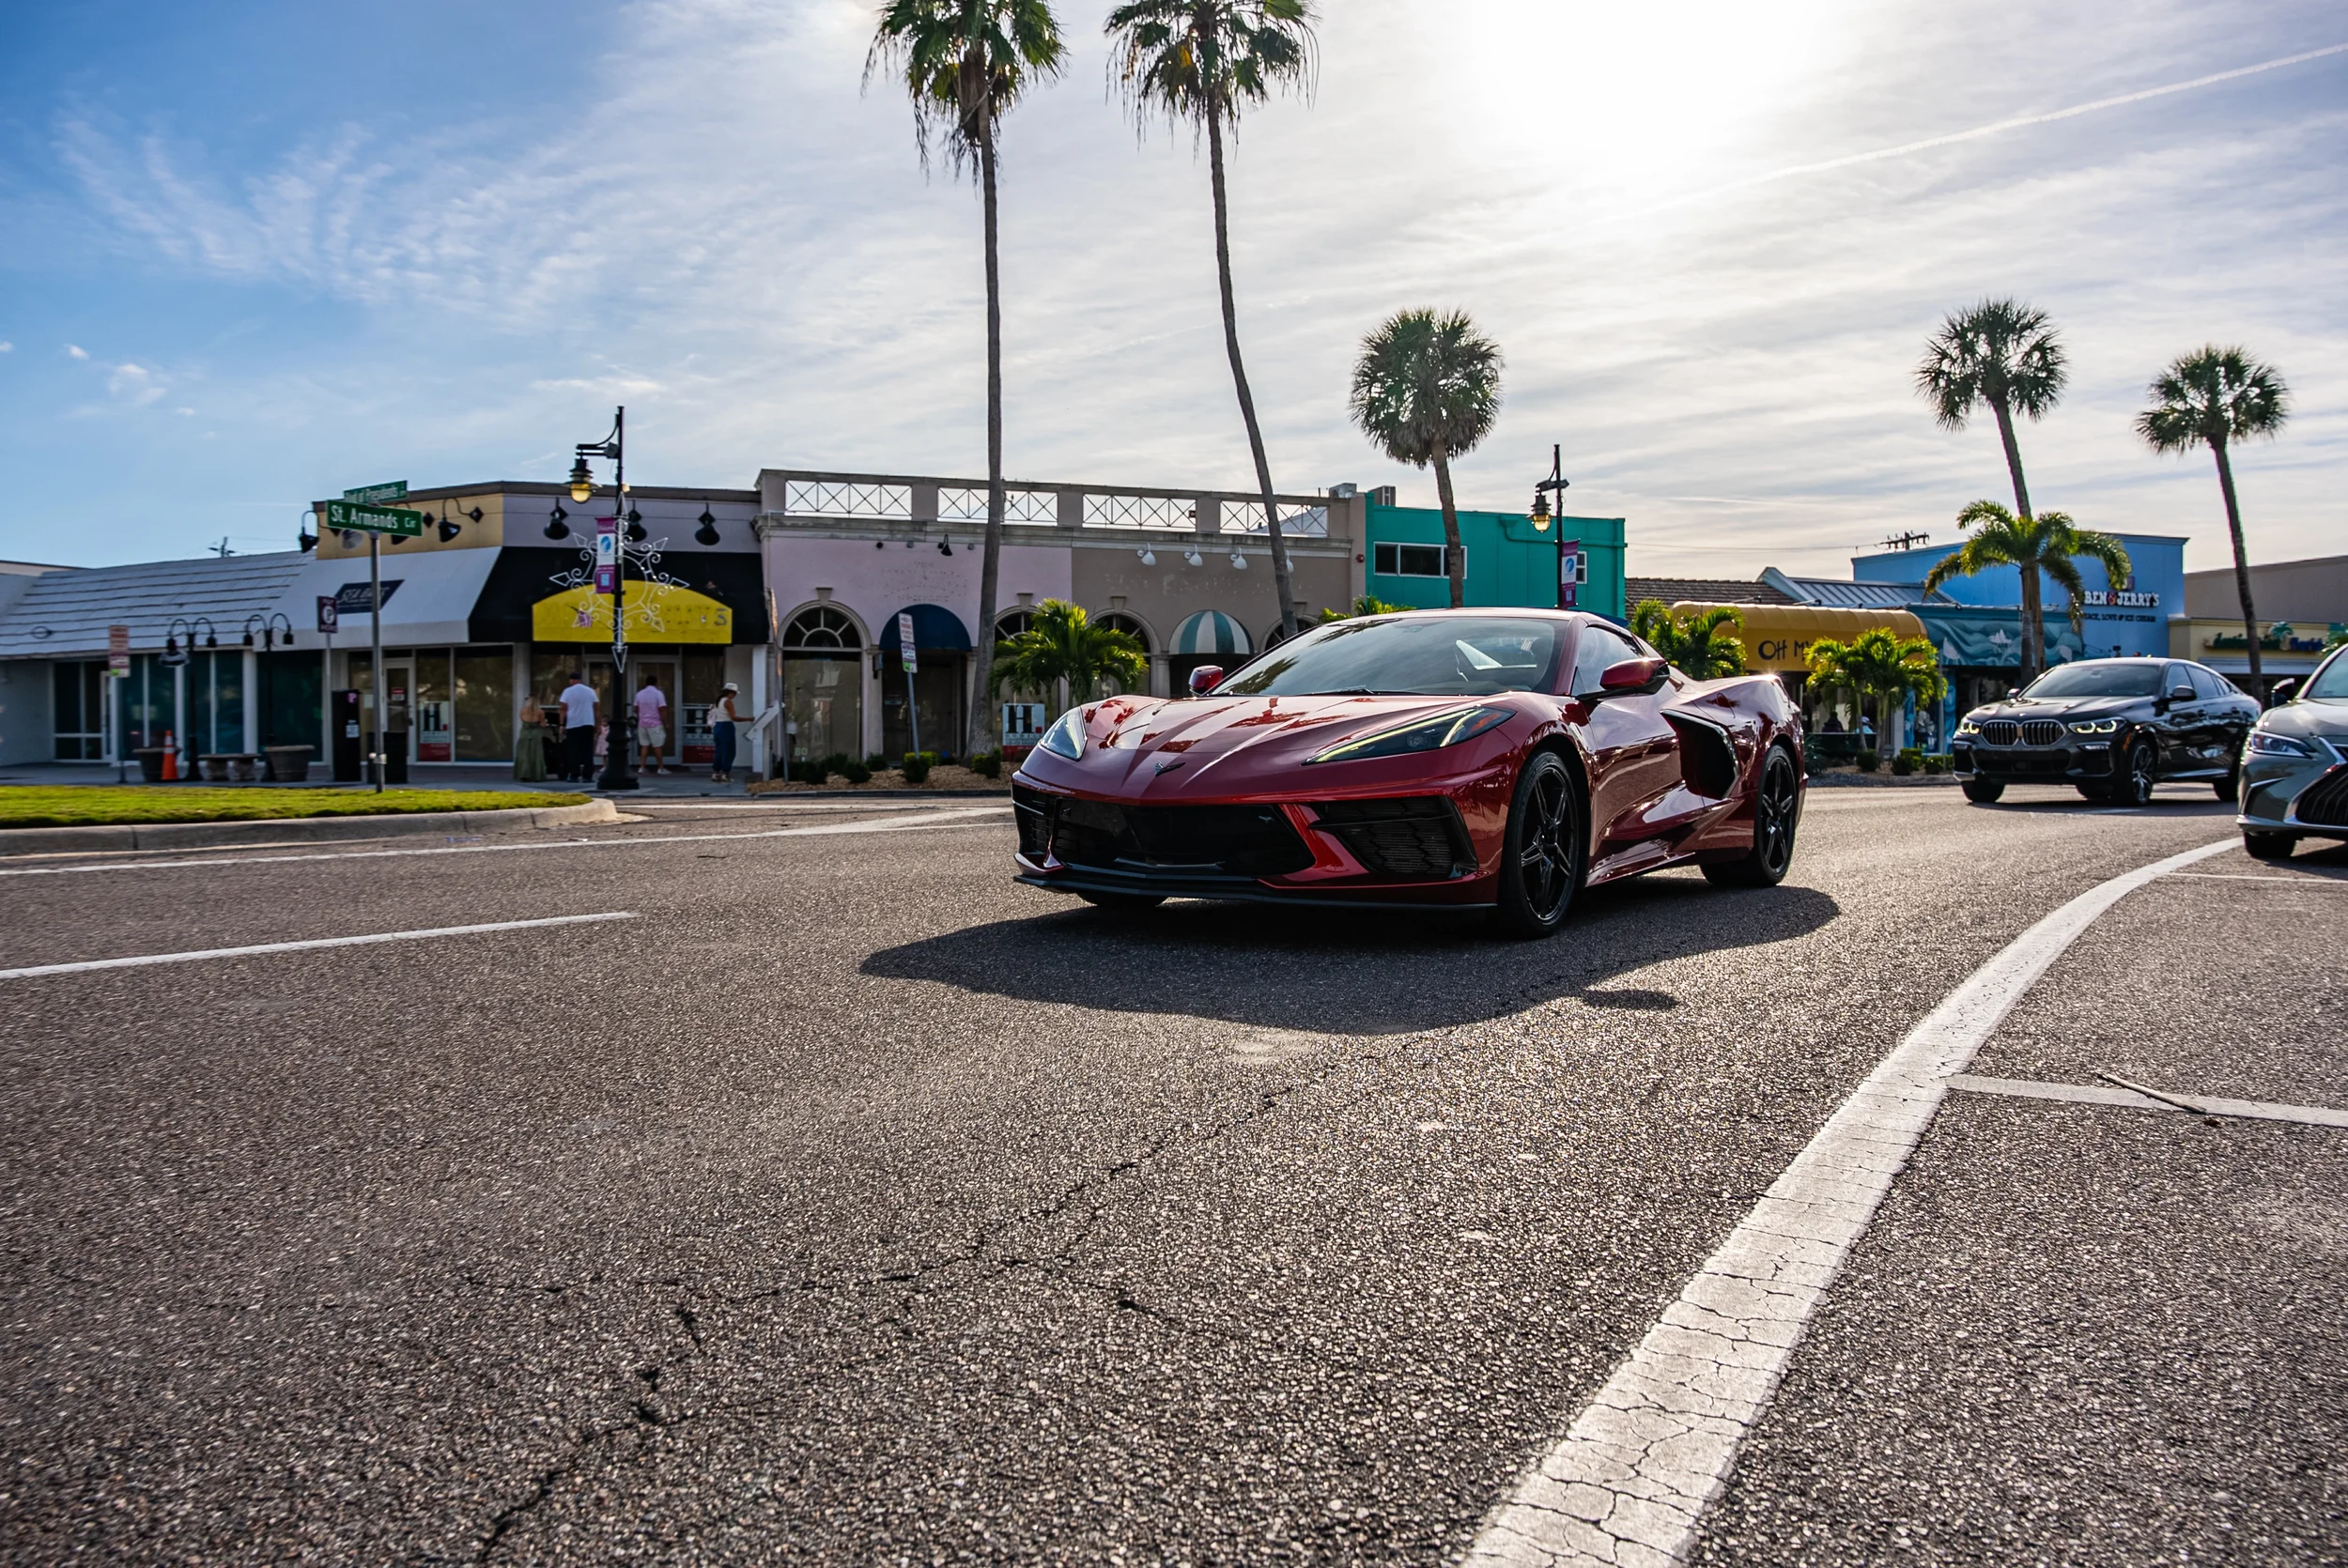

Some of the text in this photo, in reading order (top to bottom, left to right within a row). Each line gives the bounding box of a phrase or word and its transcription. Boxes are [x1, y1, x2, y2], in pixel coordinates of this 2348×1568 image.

[349, 508, 398, 529] Armands
[404, 517, 417, 528] Cir
[2084, 591, 2108, 606] BEN
[2117, 592, 2160, 607] JERRY'S
[1758, 639, 1788, 660] OH
